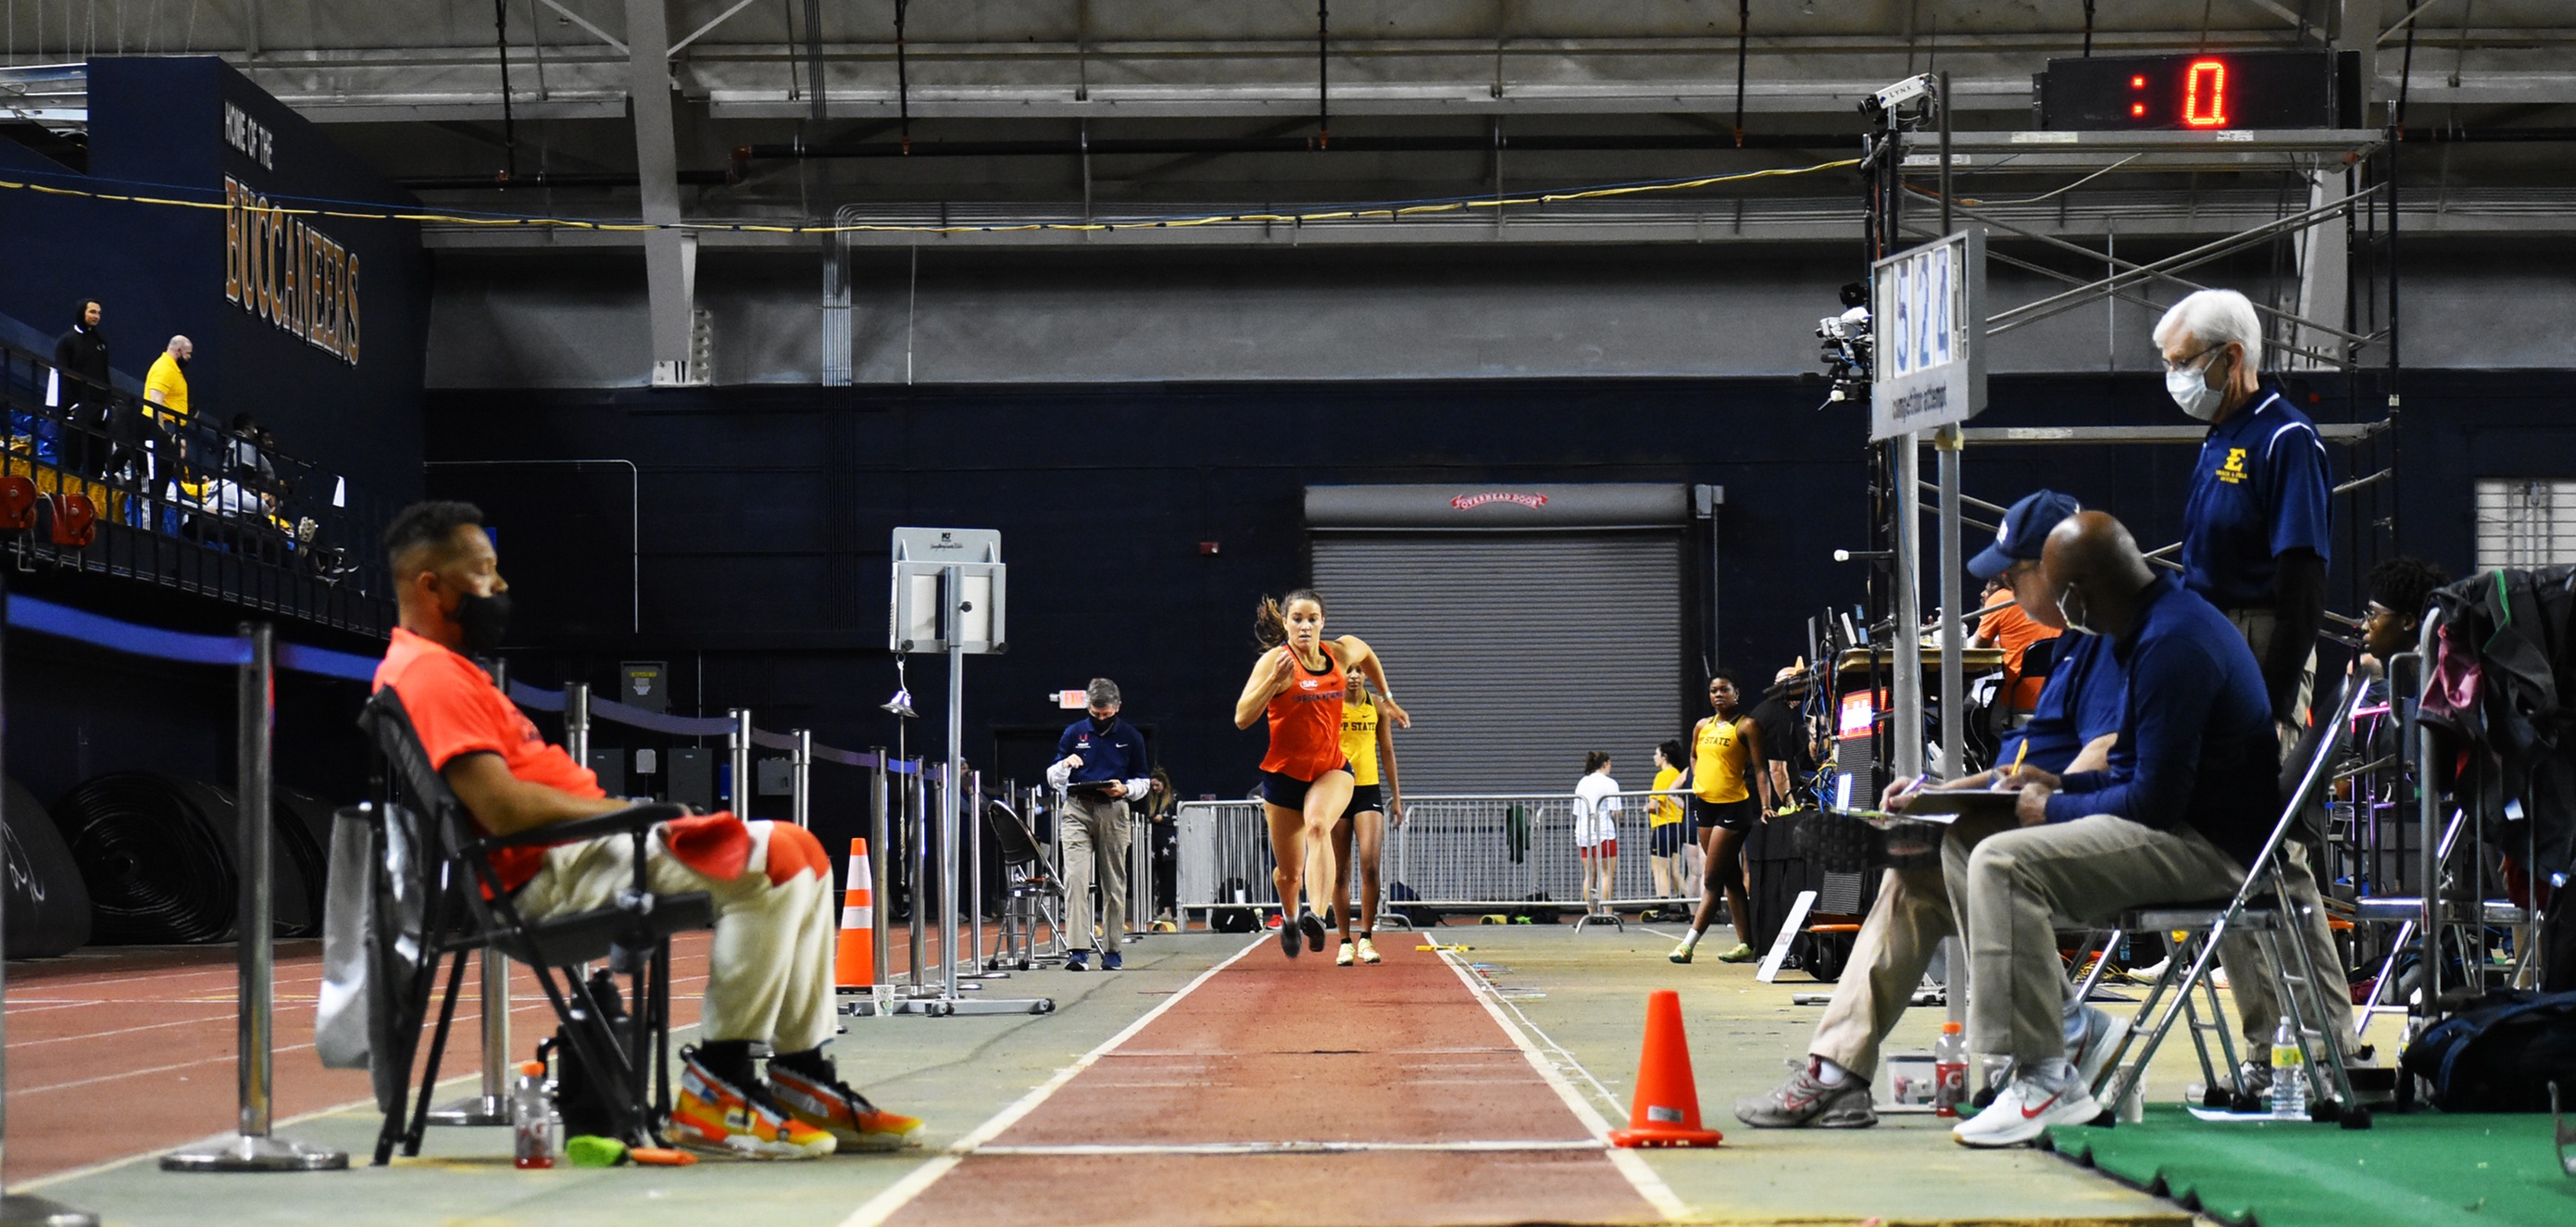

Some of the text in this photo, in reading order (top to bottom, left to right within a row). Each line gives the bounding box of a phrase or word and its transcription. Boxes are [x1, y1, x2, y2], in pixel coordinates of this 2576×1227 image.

[1889, 84, 1912, 98] LYNX
[225, 100, 273, 171] HOME OF THE
[224, 172, 359, 368] BUCCANEERS
[1461, 493, 1538, 508] OVERHEAD DOOR
[1300, 680, 1319, 689] SAC
[1351, 721, 1376, 731] STATE
[1705, 736, 1732, 747] STATE
